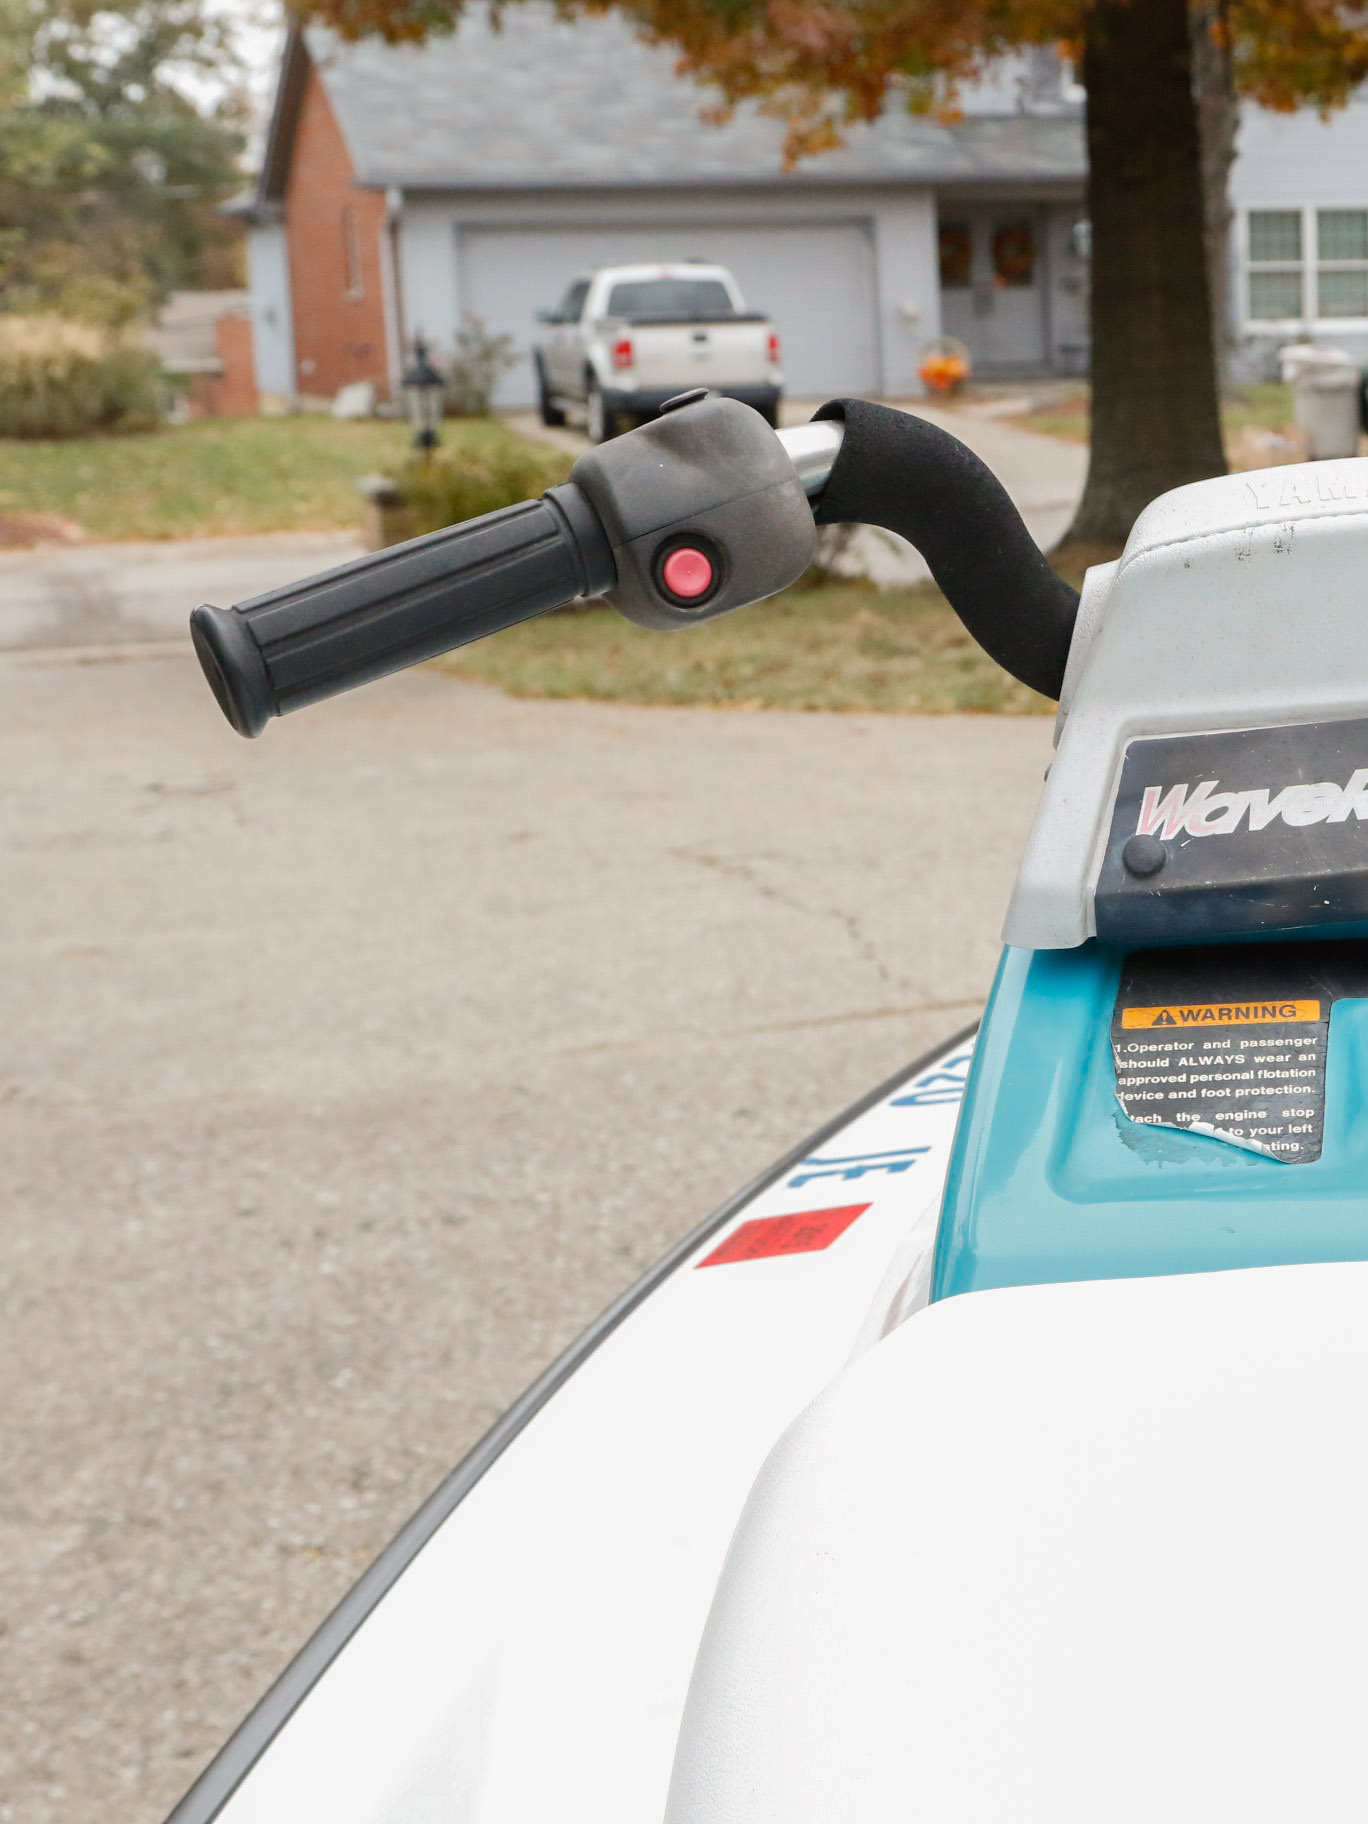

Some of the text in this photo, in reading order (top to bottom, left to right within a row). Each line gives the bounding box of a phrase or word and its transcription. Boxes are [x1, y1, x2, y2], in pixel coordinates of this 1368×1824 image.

[1179, 1004, 1297, 1022] WARNING
[1202, 1039, 1231, 1050] and
[1239, 1036, 1319, 1049] passenger
[1120, 1052, 1317, 1069] should ALWAYS wear an
[1117, 1067, 1317, 1087] approved personal flotation
[1168, 1088, 1197, 1100] and
[1200, 1086, 1232, 1099] foot
[1235, 1083, 1316, 1097] protection.
[1129, 1107, 1315, 1123] tach the engine stop
[1228, 1123, 1314, 1138] to your left
